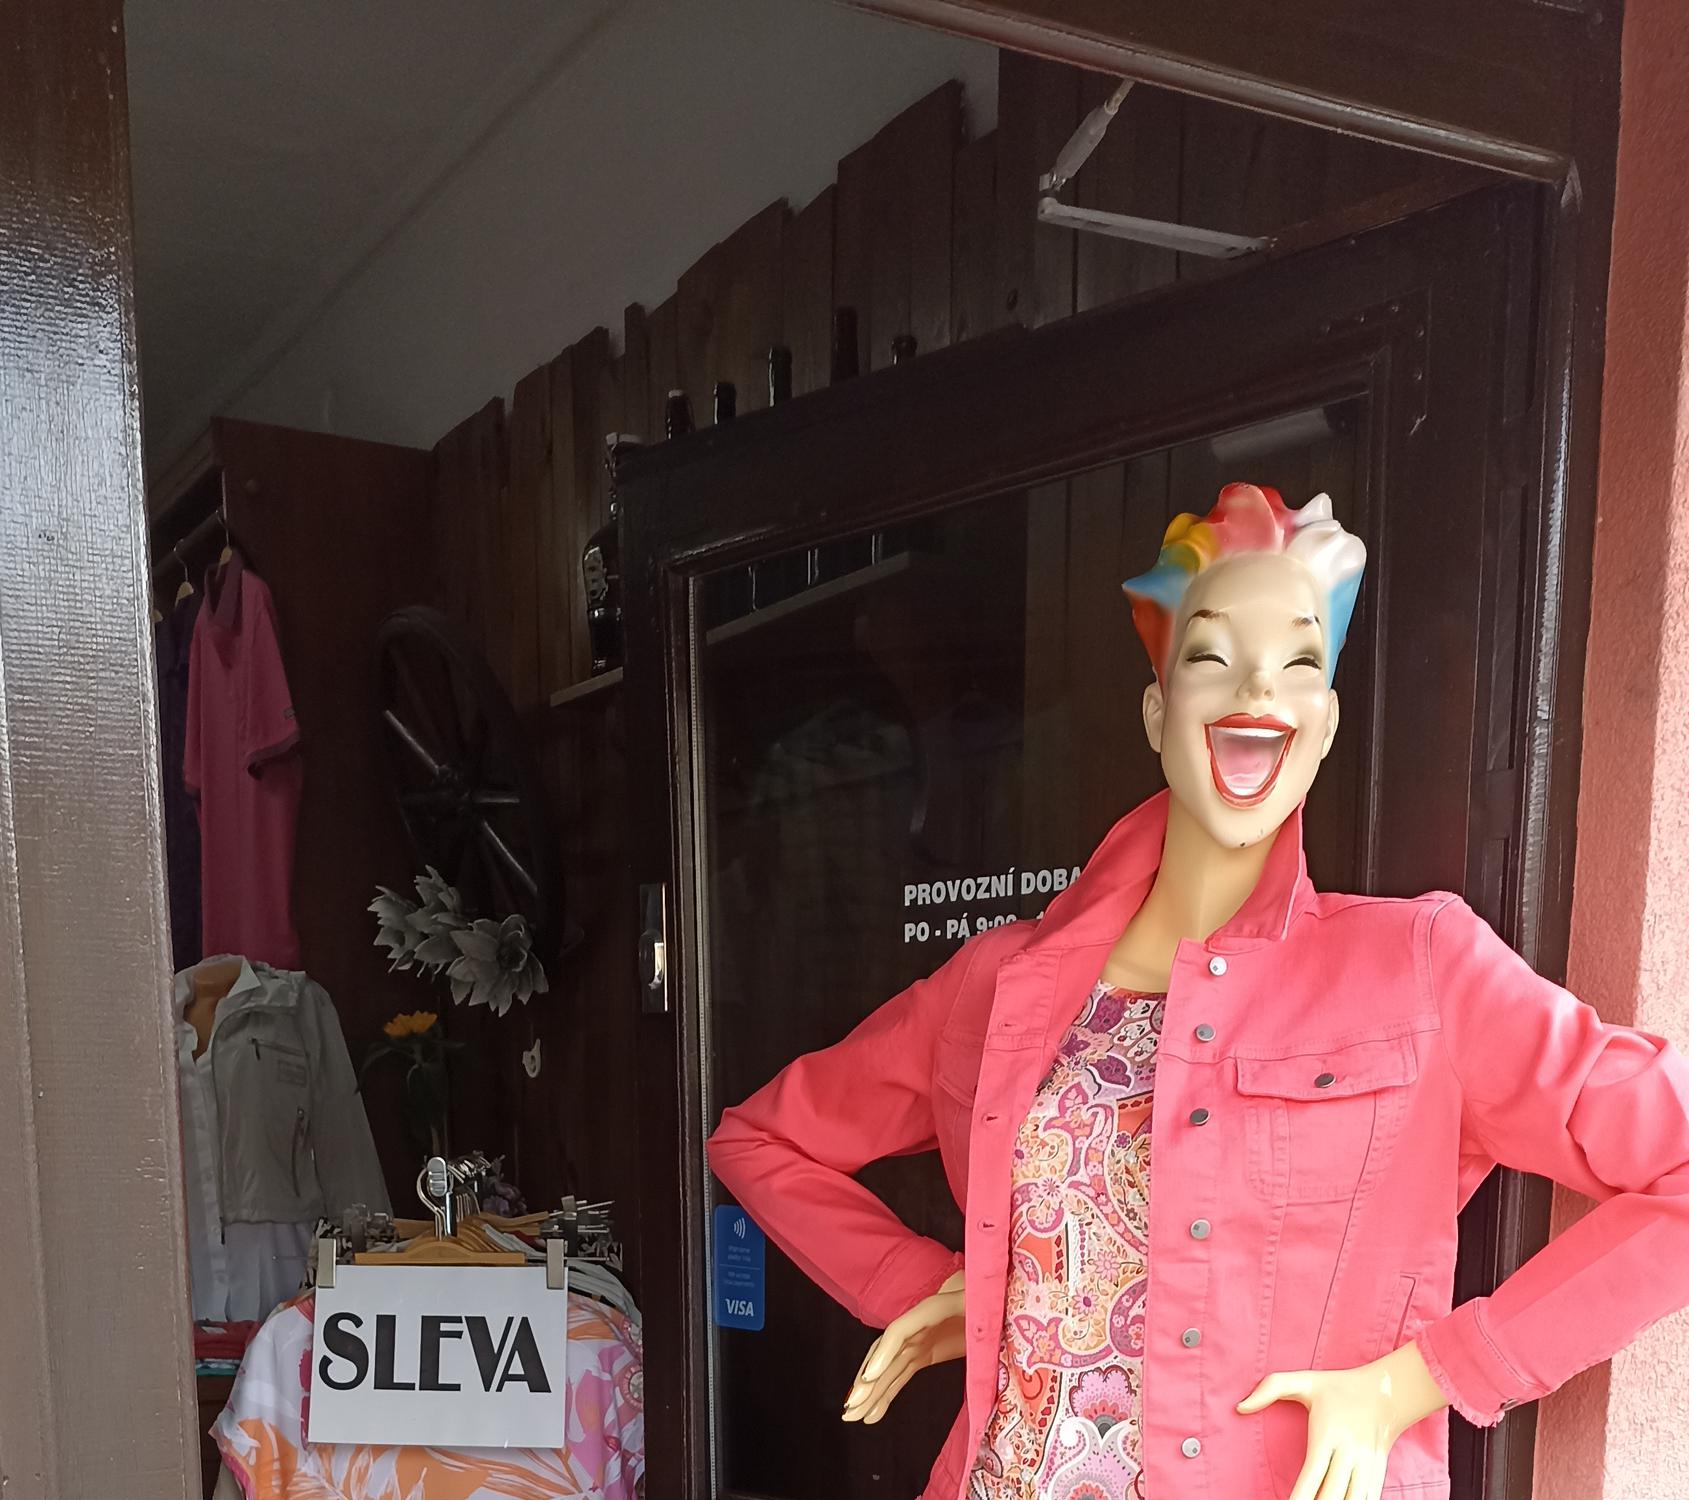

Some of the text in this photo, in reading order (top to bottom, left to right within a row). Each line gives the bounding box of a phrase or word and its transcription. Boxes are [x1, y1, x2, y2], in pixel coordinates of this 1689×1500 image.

[904, 866, 1015, 907] PROVOZNÍ
[904, 921, 930, 943] PO
[946, 912, 970, 940] PÁ
[725, 1298, 754, 1317] VISA
[318, 1312, 552, 1393] SLEVA
